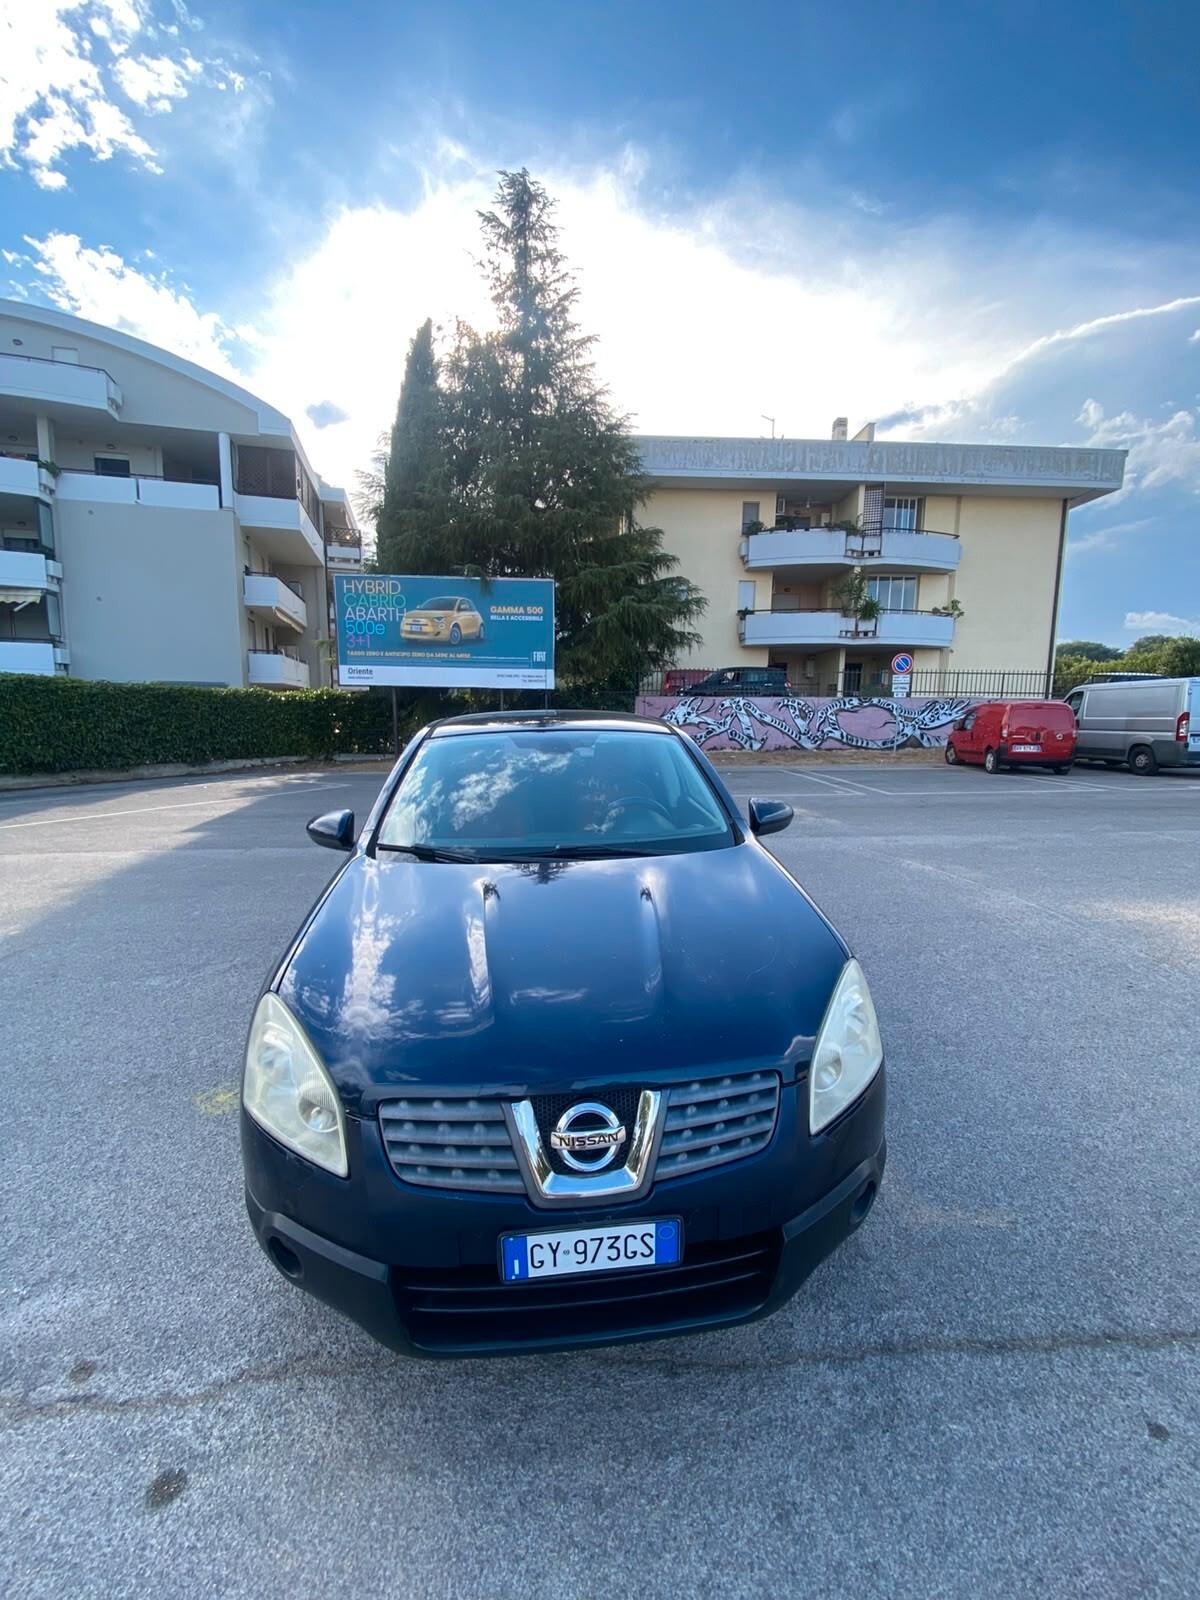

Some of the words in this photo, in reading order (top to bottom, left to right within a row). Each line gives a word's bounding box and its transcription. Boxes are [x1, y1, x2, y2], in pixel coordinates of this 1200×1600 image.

[343, 580, 401, 594] HYBRID
[343, 593, 407, 608] CABRIO
[345, 607, 407, 622] ABARTH
[490, 606, 525, 614] GAMMA
[526, 606, 544, 614] 500
[345, 620, 386, 635] 500e
[347, 667, 374, 675] Oriente
[559, 1132, 619, 1147] NISSAN
[530, 1240, 561, 1269] GY
[573, 1232, 655, 1265] 973GS
